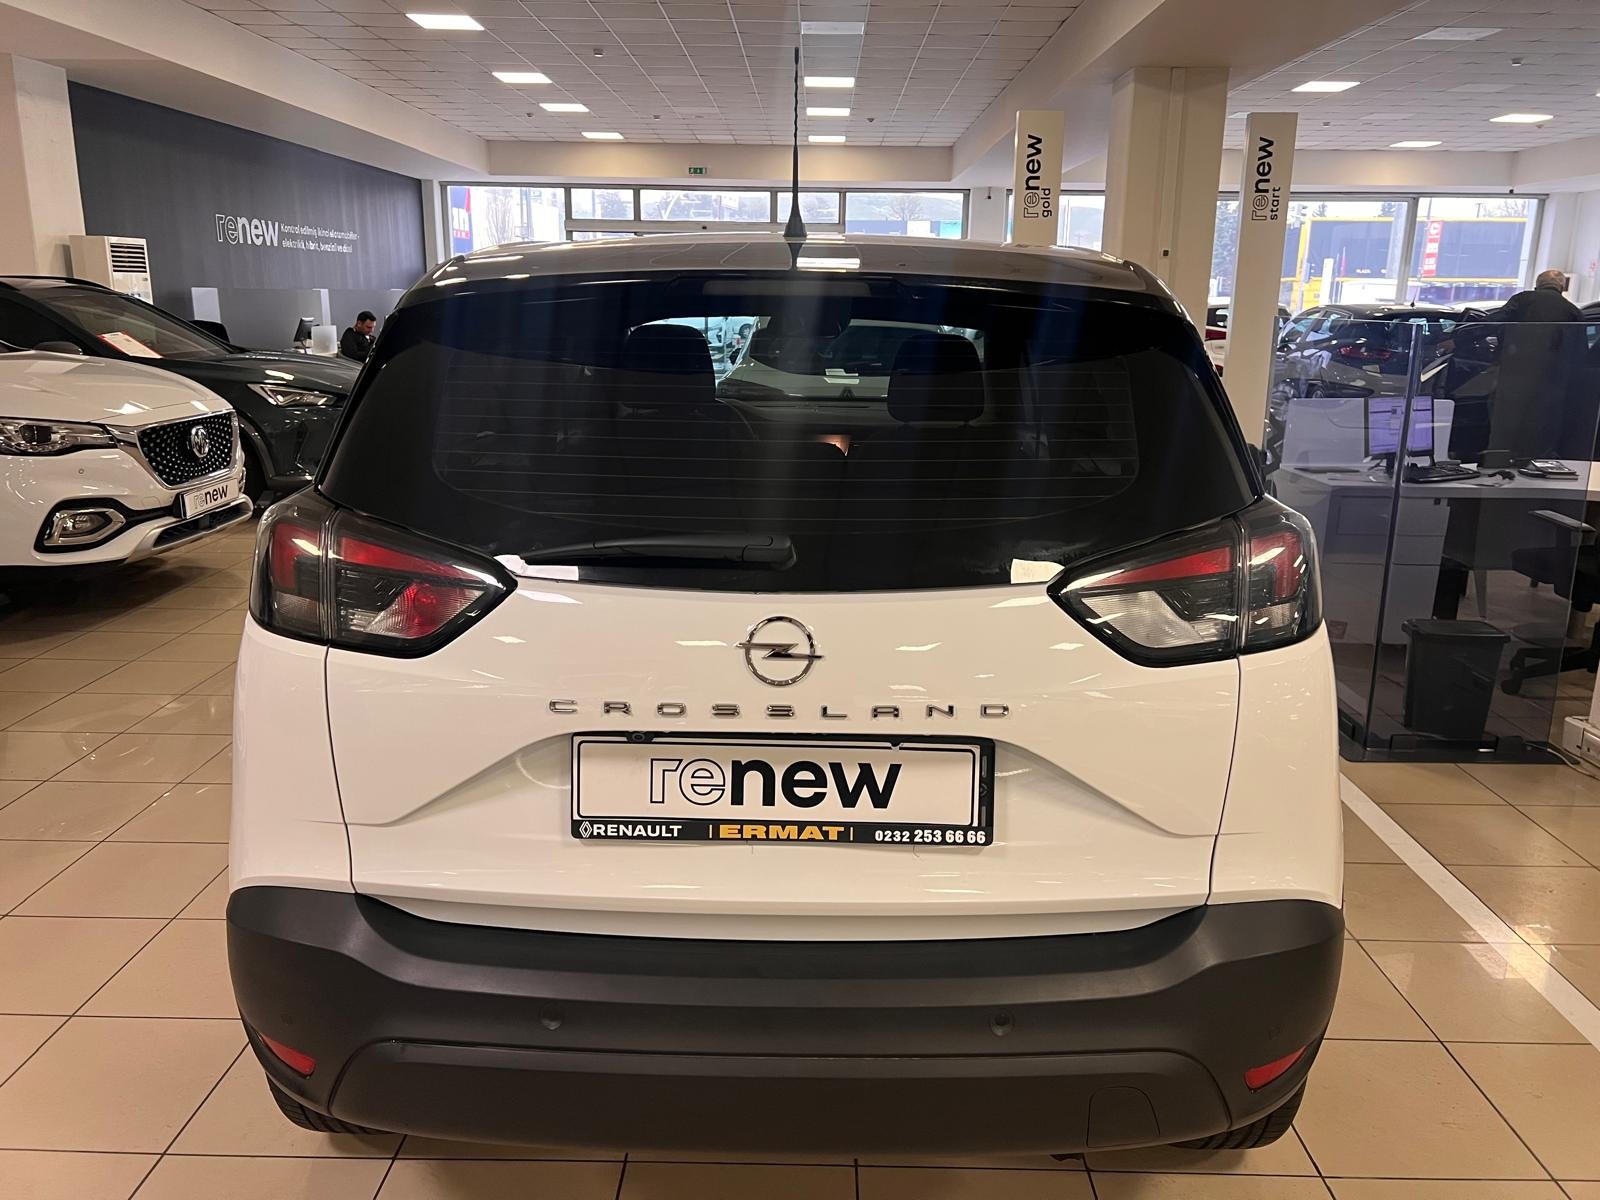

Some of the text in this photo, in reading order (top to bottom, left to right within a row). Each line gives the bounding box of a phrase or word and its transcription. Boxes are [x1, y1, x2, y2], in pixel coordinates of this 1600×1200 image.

[1023, 133, 1042, 219] renew
[1252, 136, 1274, 221] renew
[1040, 187, 1052, 218] gold
[1270, 187, 1281, 221] start
[215, 213, 279, 247] renew
[193, 485, 228, 509] renew
[549, 699, 1010, 719] CROSSLAND
[650, 757, 903, 810] renew
[593, 824, 986, 845] RENAULT ERMAT 0232 253 66 66
